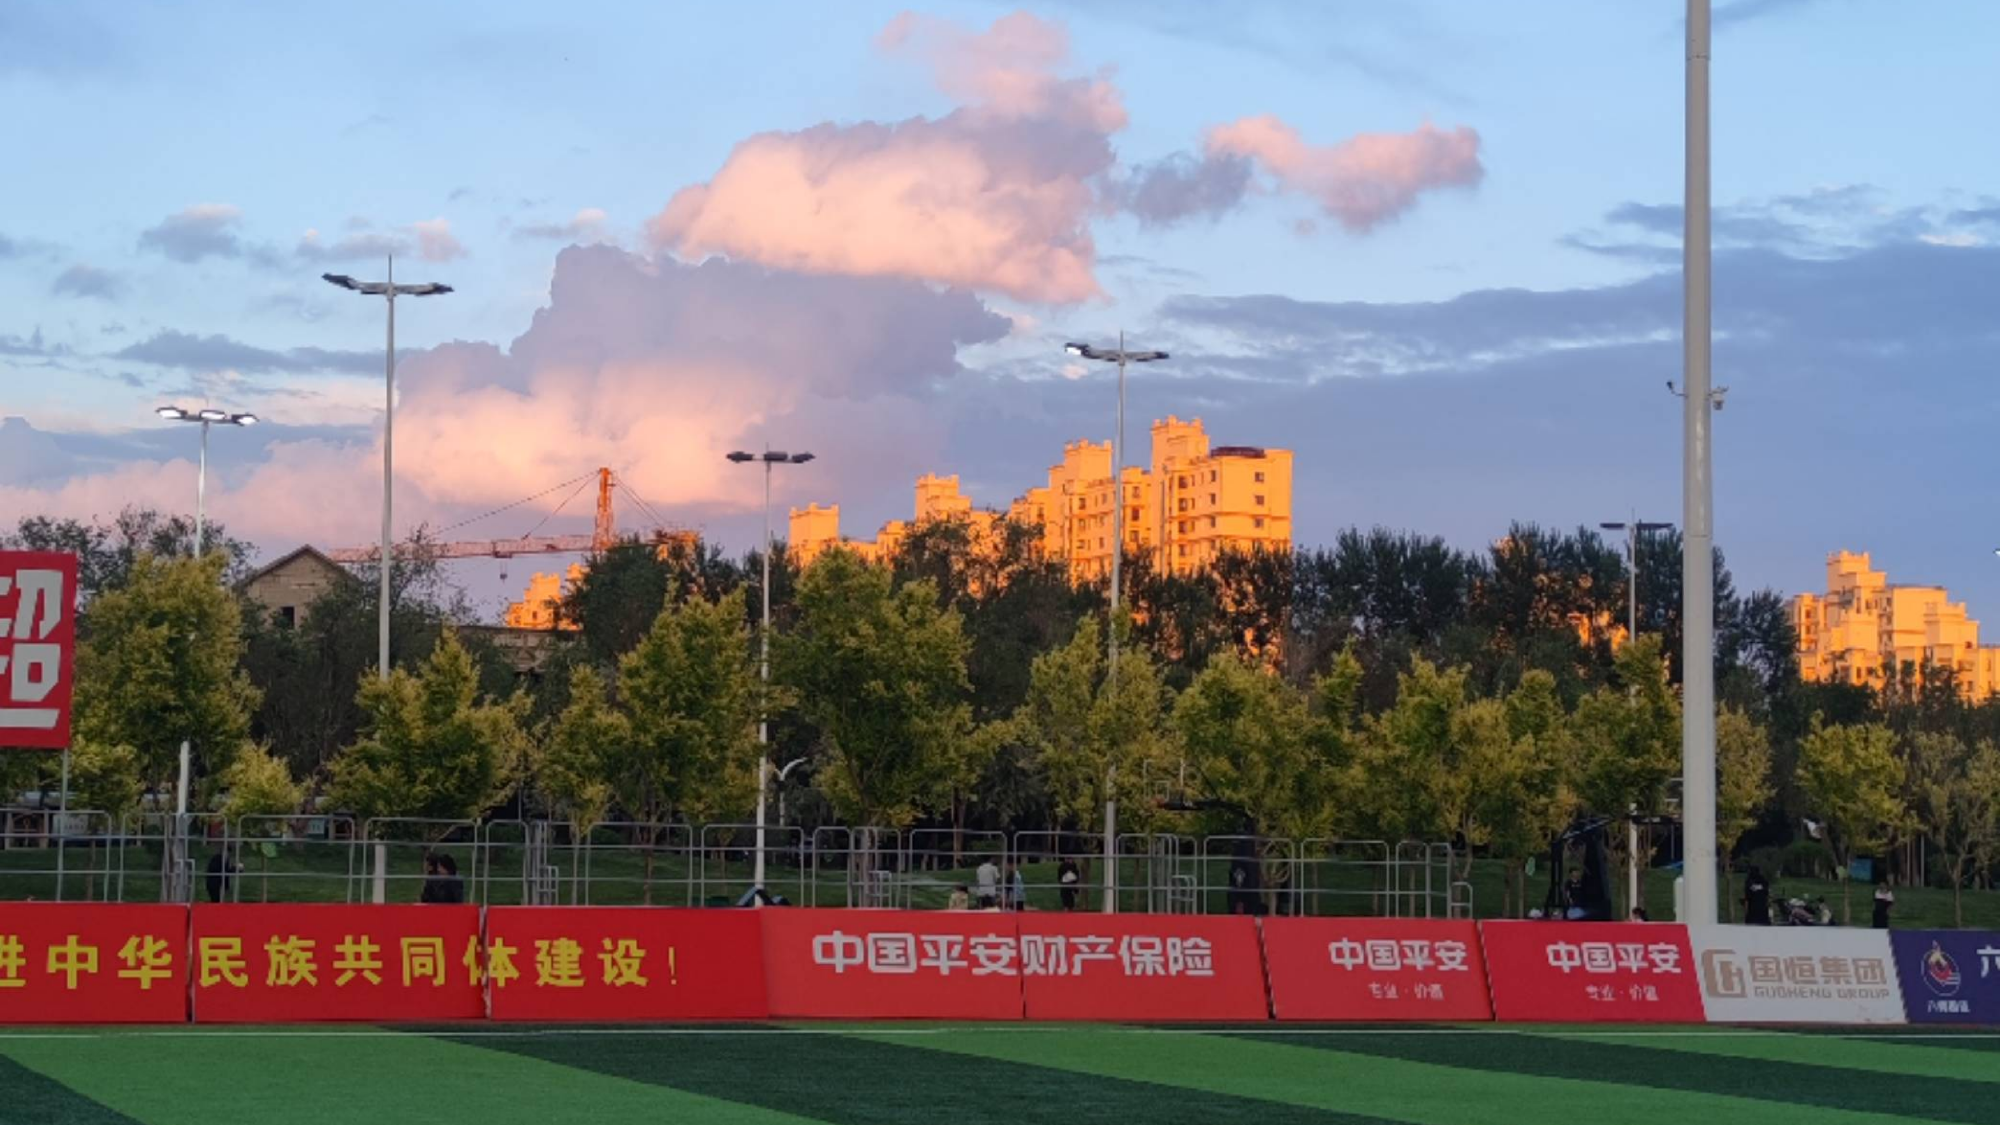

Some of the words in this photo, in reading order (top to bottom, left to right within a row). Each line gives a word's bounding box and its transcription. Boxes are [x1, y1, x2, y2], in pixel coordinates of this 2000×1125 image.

[812, 930, 1215, 977] 中国平安财产保险
[1328, 937, 1469, 971] 中国平安
[1546, 941, 1682, 974] 中国平安
[1748, 955, 1888, 985] 国恒集团
[1753, 985, 1833, 999] GUOHENG
[1837, 986, 1890, 999] GROUP
